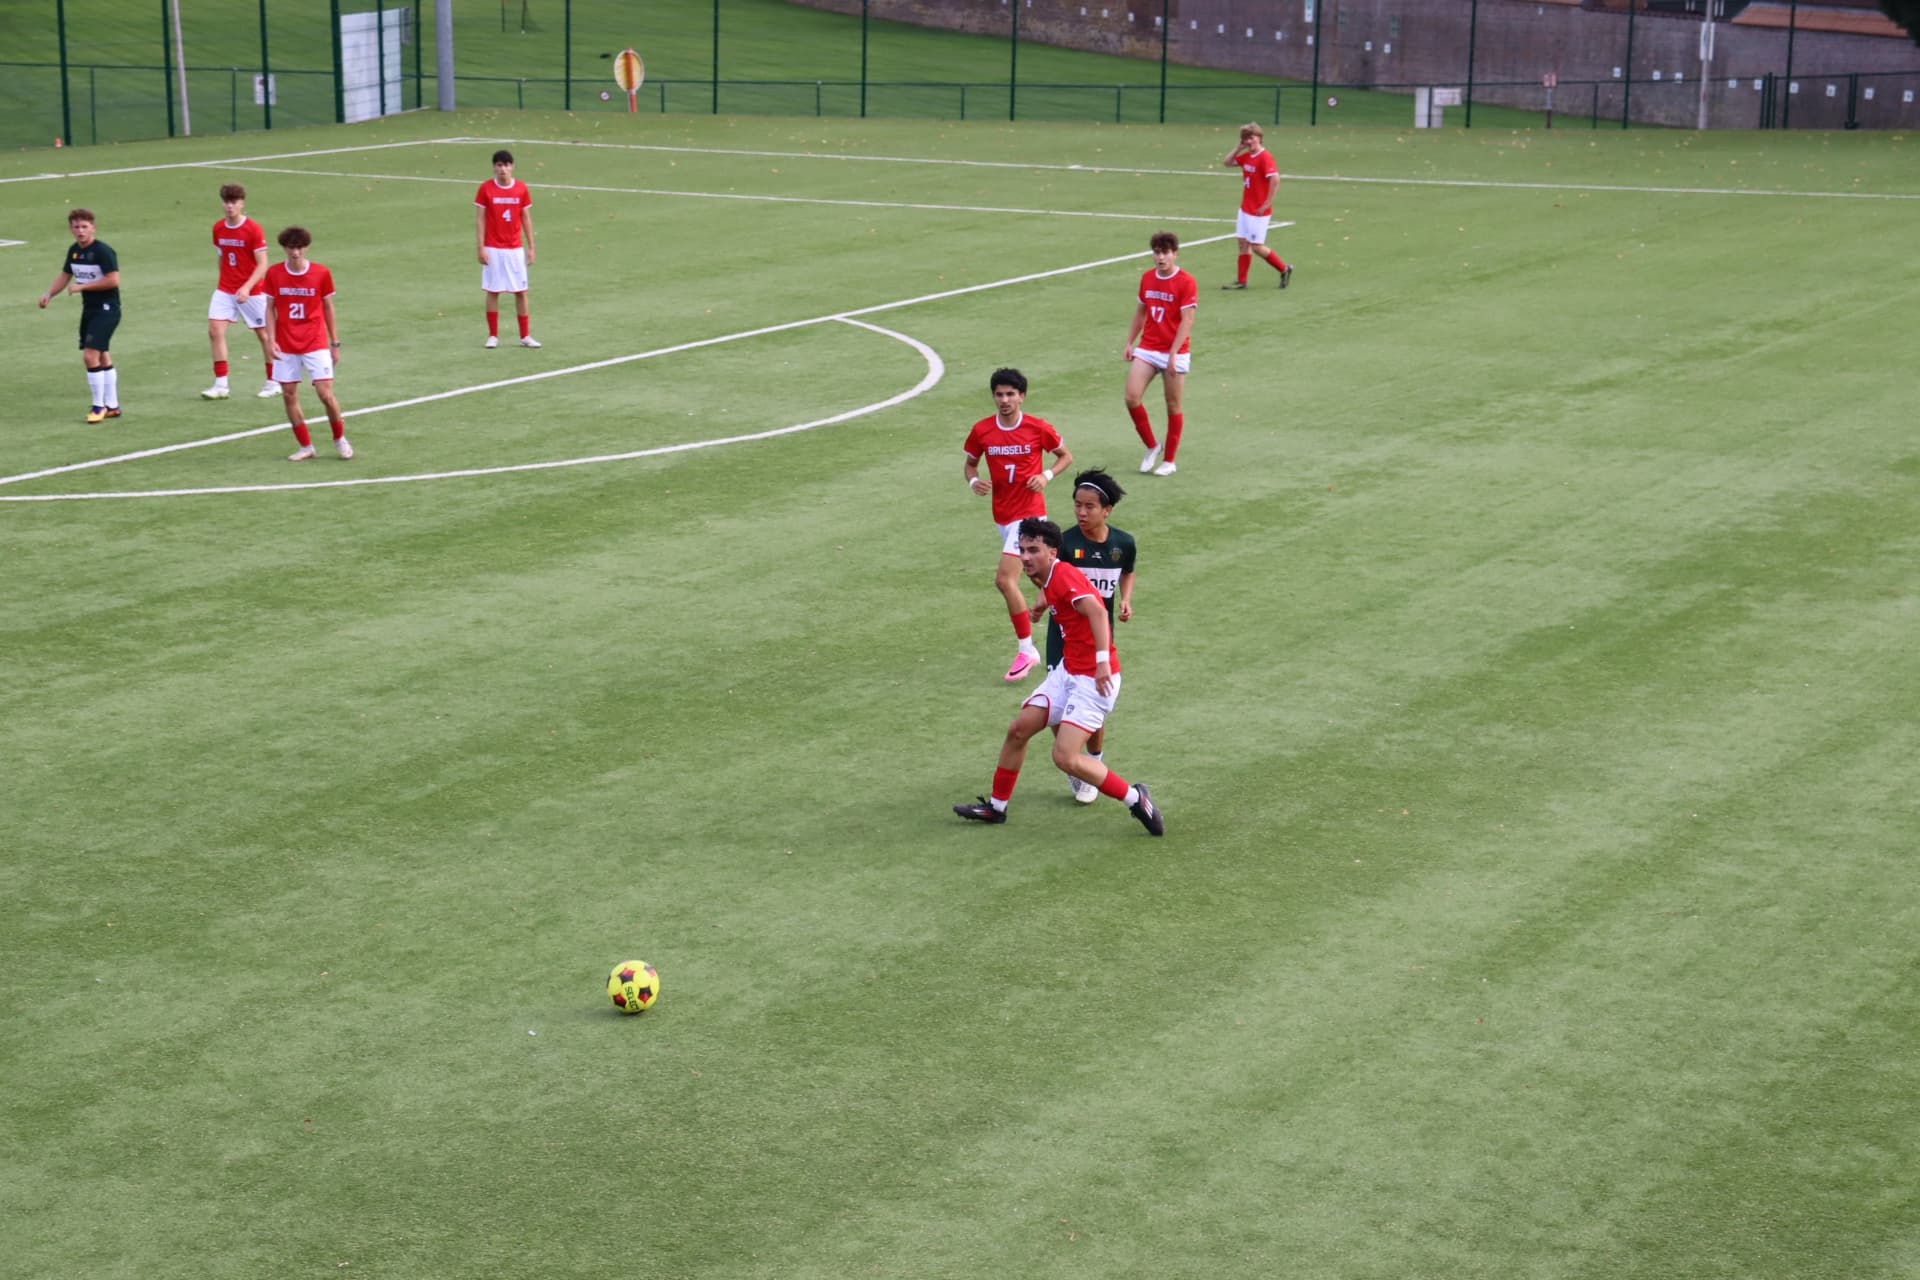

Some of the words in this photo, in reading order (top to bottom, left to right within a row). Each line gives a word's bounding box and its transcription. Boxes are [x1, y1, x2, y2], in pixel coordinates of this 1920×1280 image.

[502, 209, 512, 222] 4
[279, 287, 316, 296] BRUSSELS
[1145, 290, 1174, 302] BRUSSELS
[289, 303, 304, 319] 21
[1151, 306, 1165, 322] 17
[988, 444, 1031, 455] BRUSSELS
[1004, 464, 1016, 484] 7
[1087, 578, 1117, 591] ons
[624, 986, 640, 1010] SELECT
